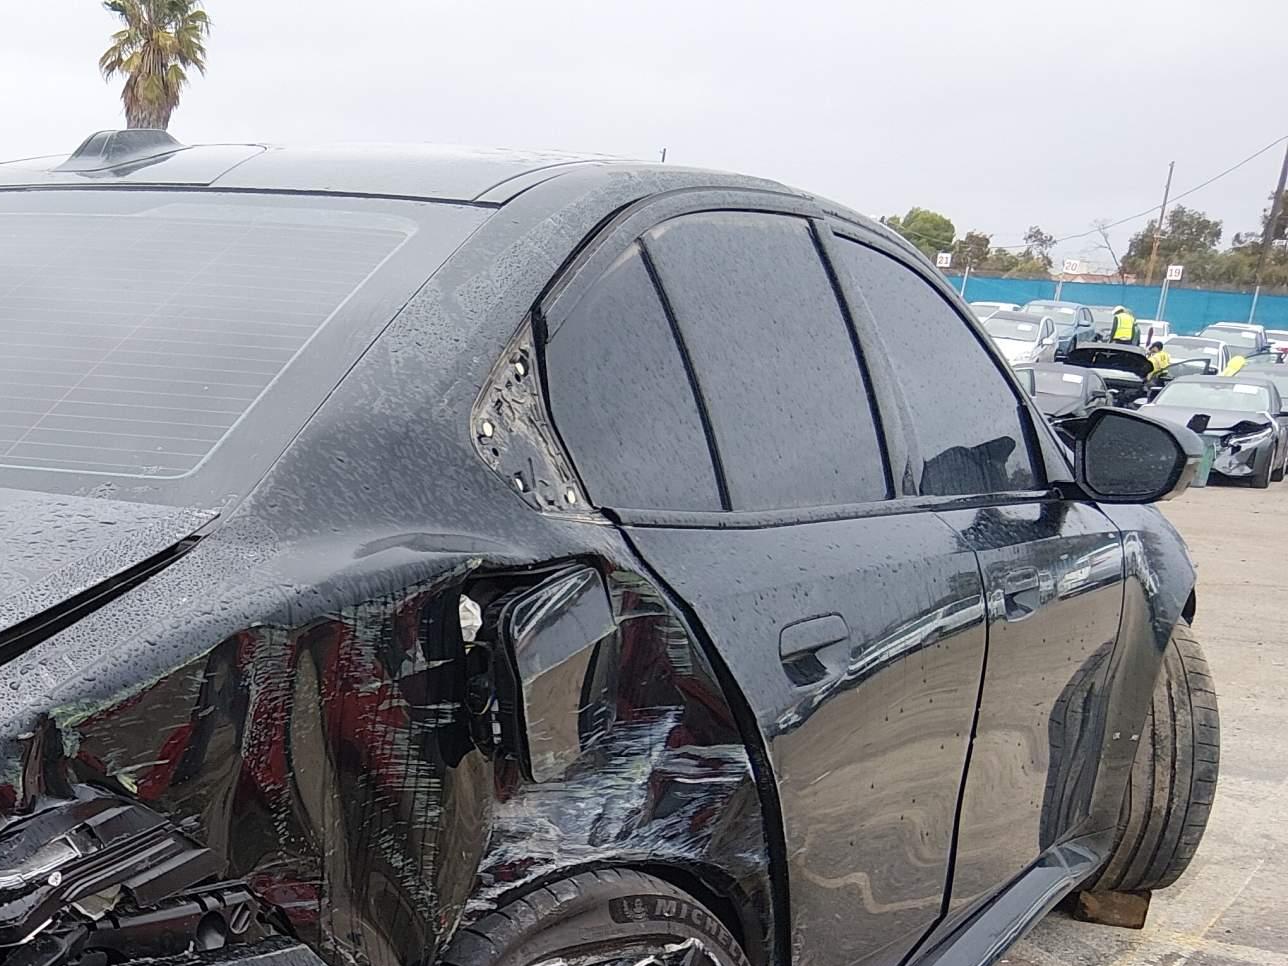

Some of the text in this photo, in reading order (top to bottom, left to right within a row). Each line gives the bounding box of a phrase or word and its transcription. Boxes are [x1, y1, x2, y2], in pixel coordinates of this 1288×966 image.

[938, 256, 949, 265] 21
[1064, 261, 1078, 272] 20
[1168, 268, 1181, 278] 19
